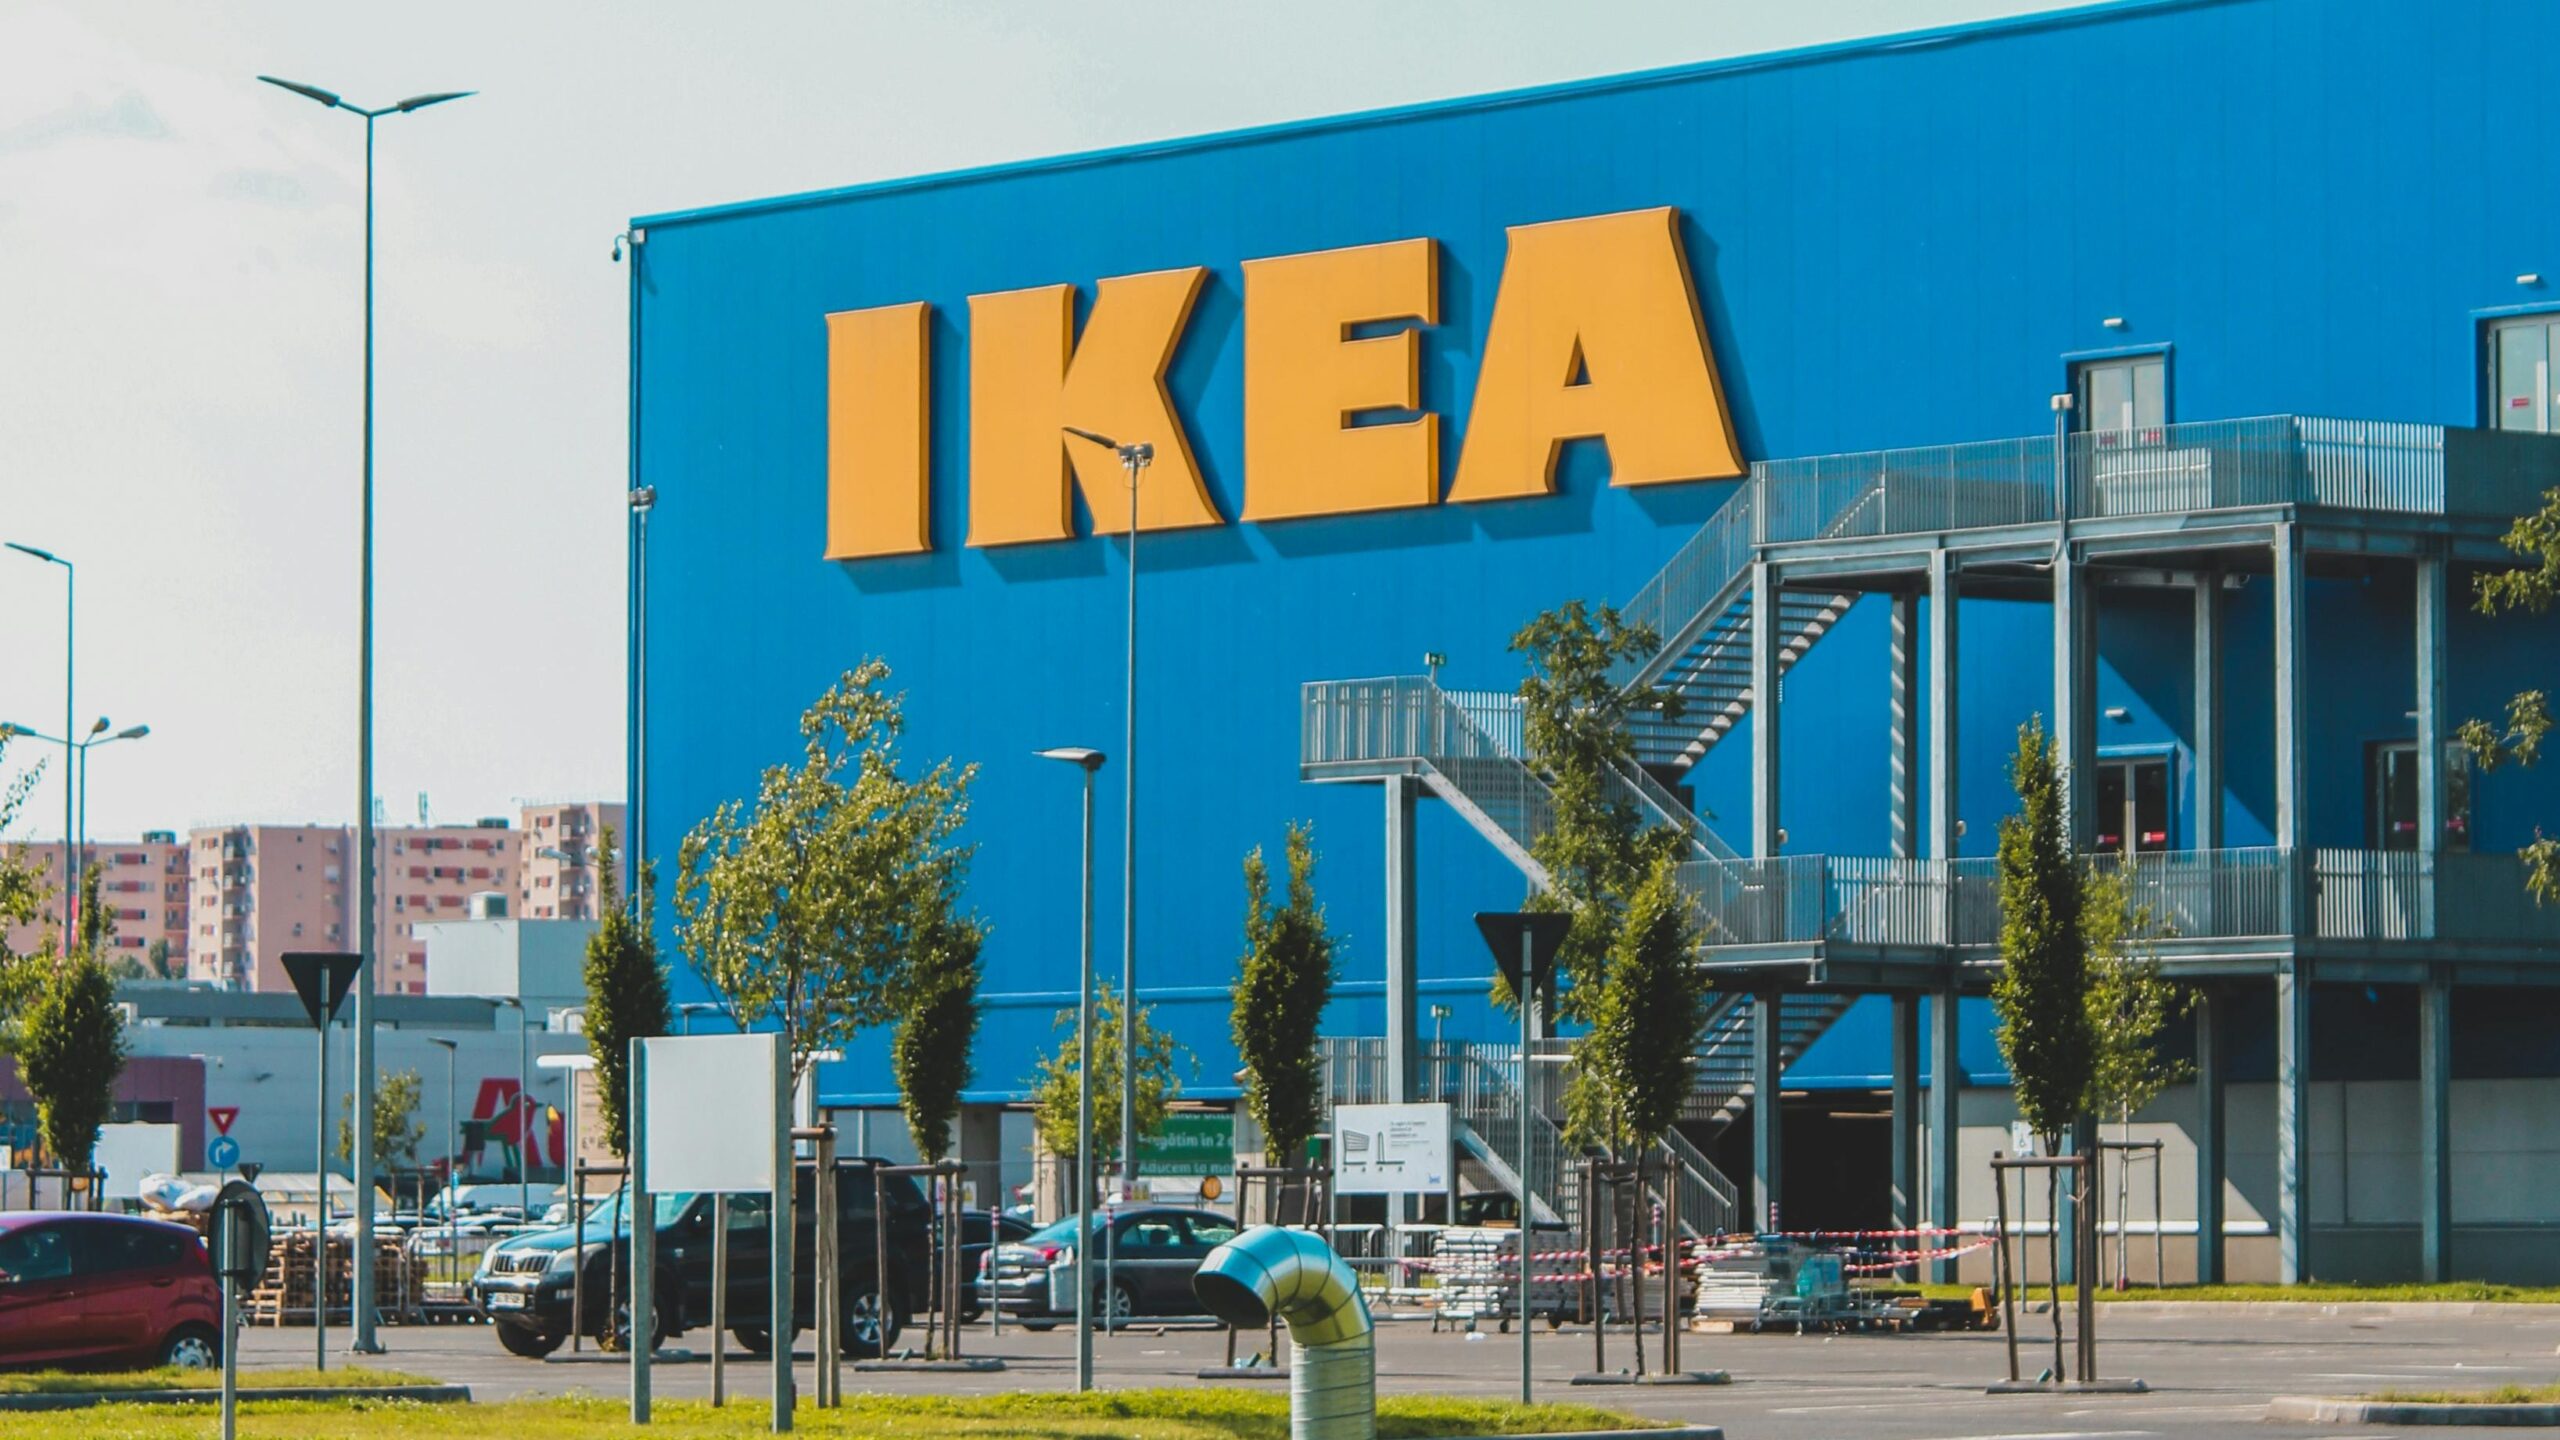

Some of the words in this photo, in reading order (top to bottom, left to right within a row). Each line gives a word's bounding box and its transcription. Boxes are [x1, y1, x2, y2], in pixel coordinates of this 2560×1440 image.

[823, 206, 1749, 561] IKEA
[1216, 1132, 1225, 1147] 2
[1138, 1160, 1191, 1174] Aducem
